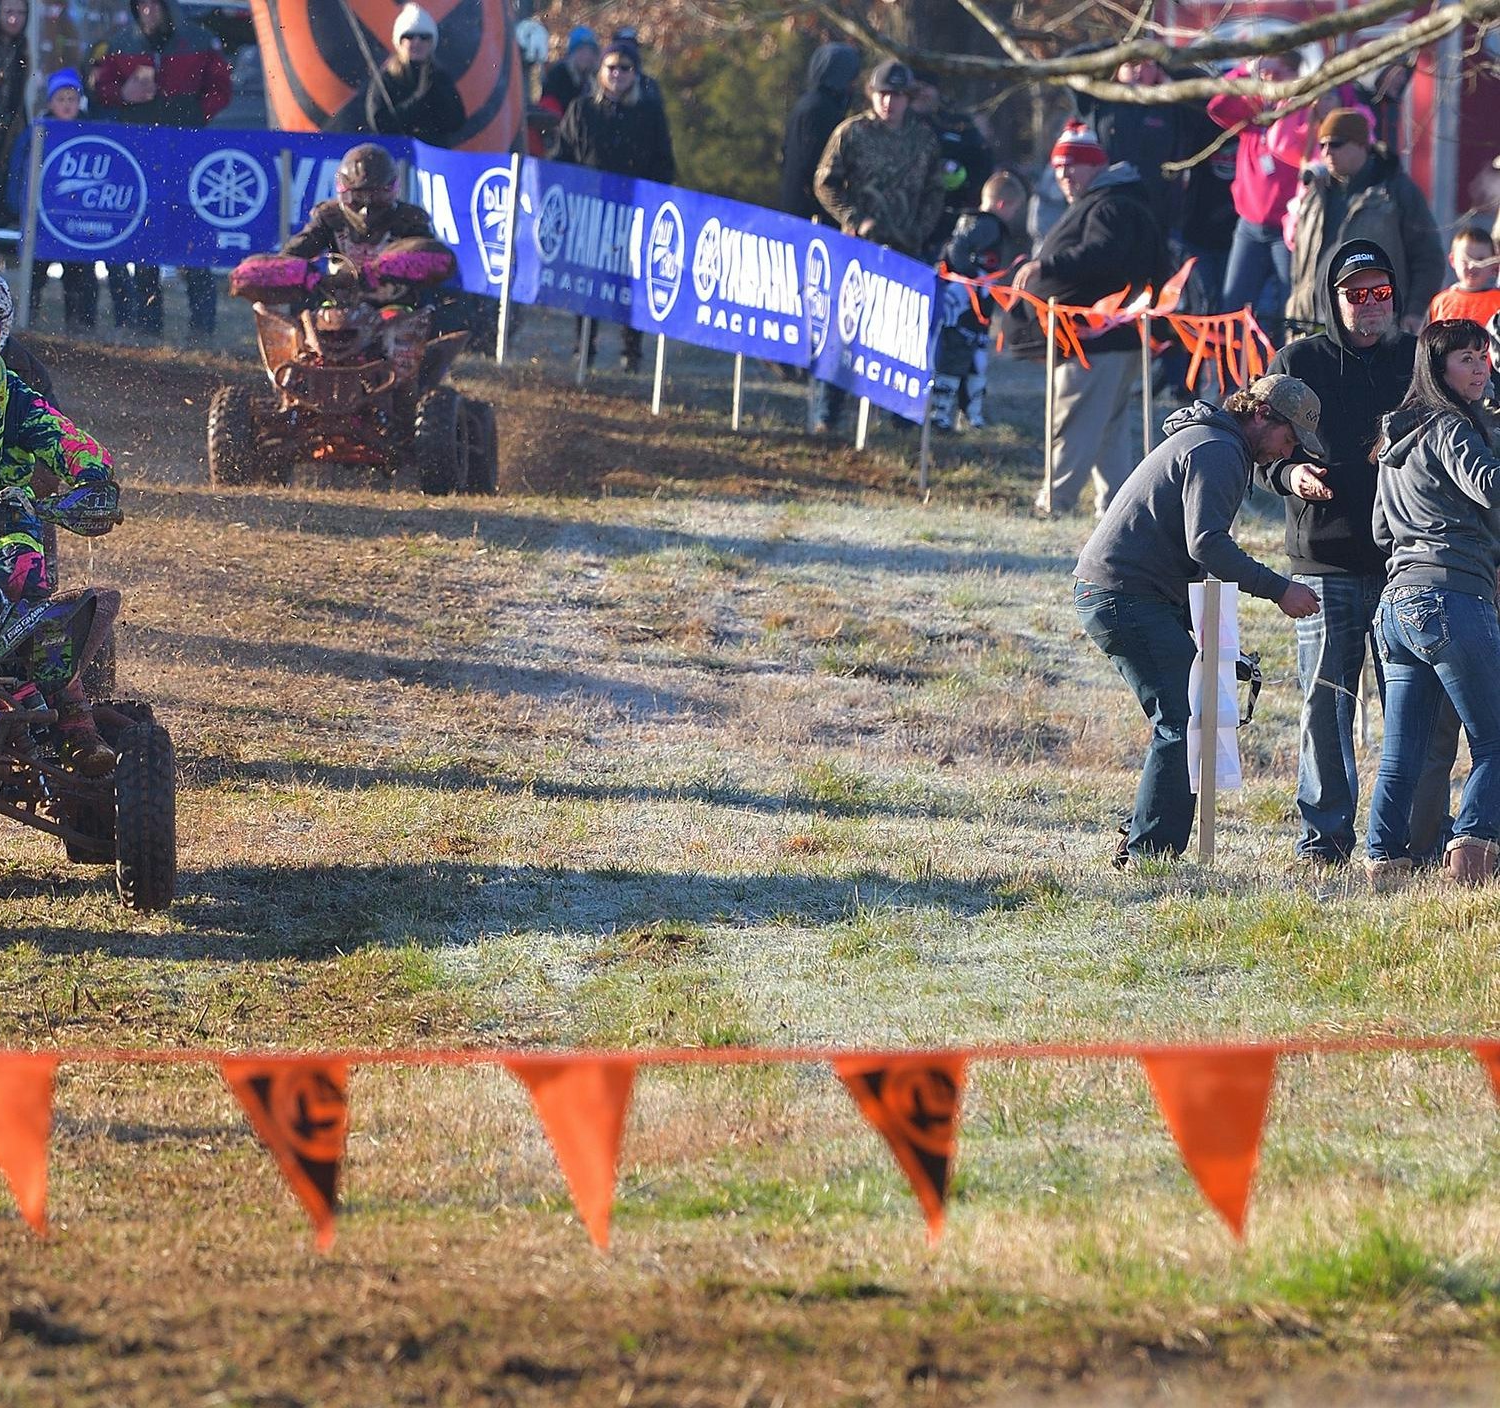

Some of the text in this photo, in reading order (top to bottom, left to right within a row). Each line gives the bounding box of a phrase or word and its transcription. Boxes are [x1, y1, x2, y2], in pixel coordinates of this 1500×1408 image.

[564, 191, 645, 281] YAMAHA
[541, 268, 633, 306] RACING
[719, 226, 804, 318] YAMAHA
[696, 304, 800, 345] RACING
